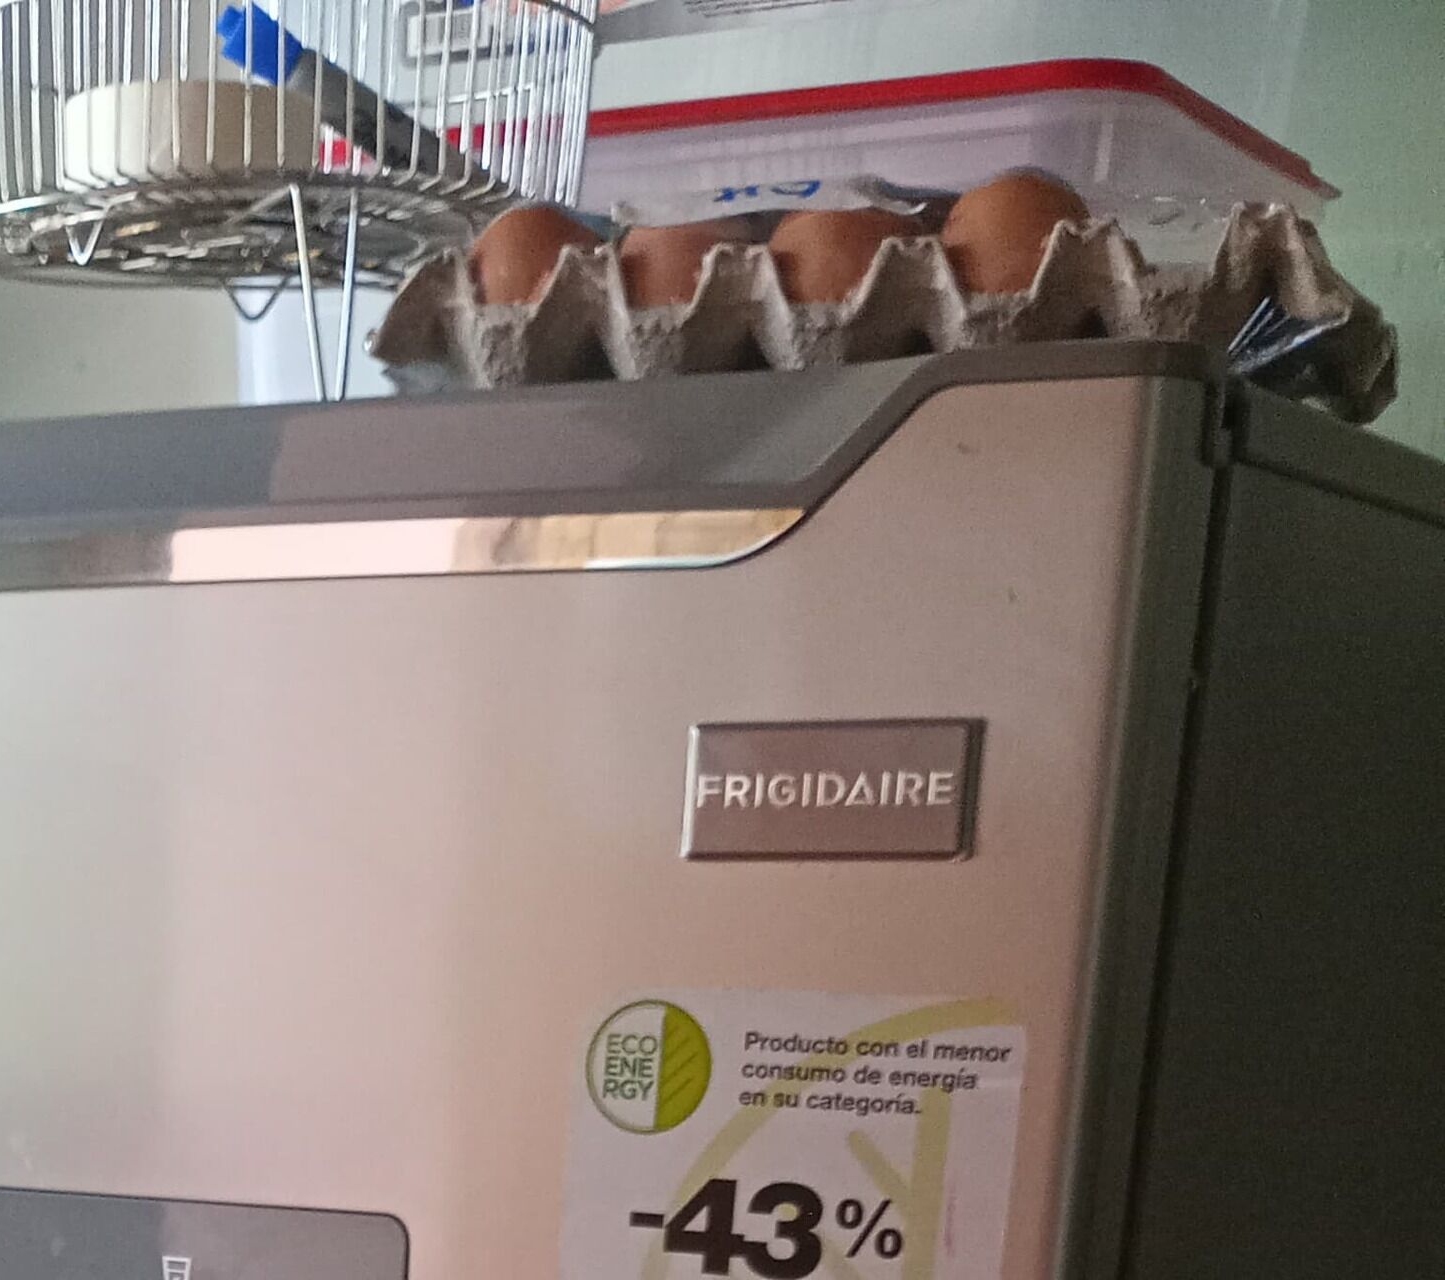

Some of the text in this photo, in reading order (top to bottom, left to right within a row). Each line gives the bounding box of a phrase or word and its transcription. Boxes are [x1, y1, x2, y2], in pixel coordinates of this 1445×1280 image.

[696, 770, 955, 809] FRIGIDAIRE
[606, 1033, 658, 1055] ECO
[743, 1031, 1012, 1063] Producto con el menor
[604, 1056, 654, 1078] ENE
[740, 1062, 979, 1094] consumo de energía
[602, 1079, 655, 1101] RGY
[737, 1089, 923, 1117] en su categoría.
